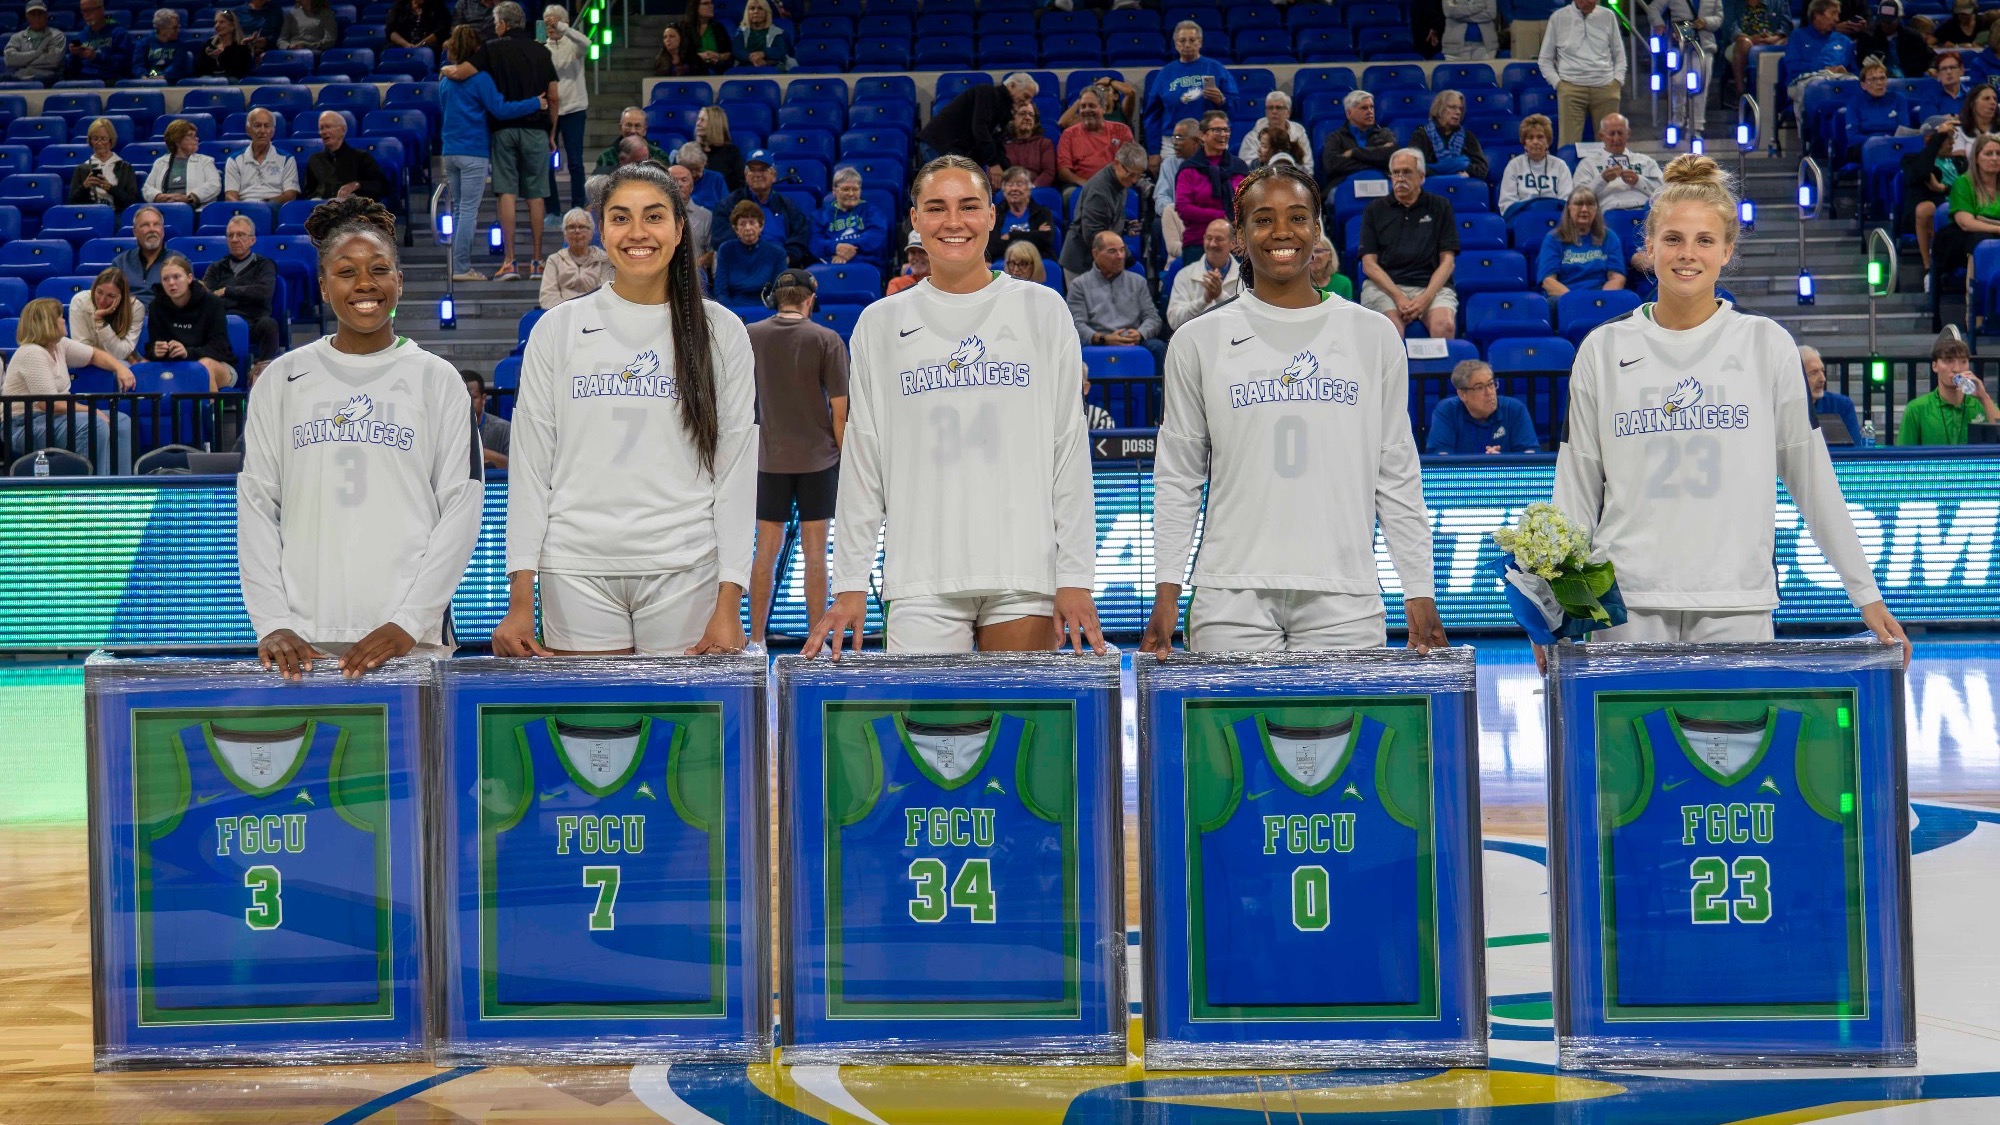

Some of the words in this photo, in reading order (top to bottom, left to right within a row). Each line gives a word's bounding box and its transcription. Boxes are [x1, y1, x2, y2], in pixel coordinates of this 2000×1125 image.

[1168, 75, 1203, 92] FGC
[572, 374, 682, 400] RAINING3
[900, 361, 1030, 396] RAINING3S
[1230, 378, 1359, 409] RAINING3S
[293, 418, 415, 451] RAINING3S
[1614, 404, 1749, 437] RAINING3S
[1122, 438, 1155, 457] poss
[216, 814, 307, 857] FGCU
[556, 814, 646, 855] FGCU
[904, 806, 996, 847] FGCU
[1263, 812, 1356, 855] FGCU
[1681, 802, 1775, 846] FGCU
[244, 864, 283, 931] 3
[582, 865, 621, 931] 7
[908, 857, 997, 924] 34
[1291, 864, 1331, 932] 0
[1689, 855, 1773, 925] 23
